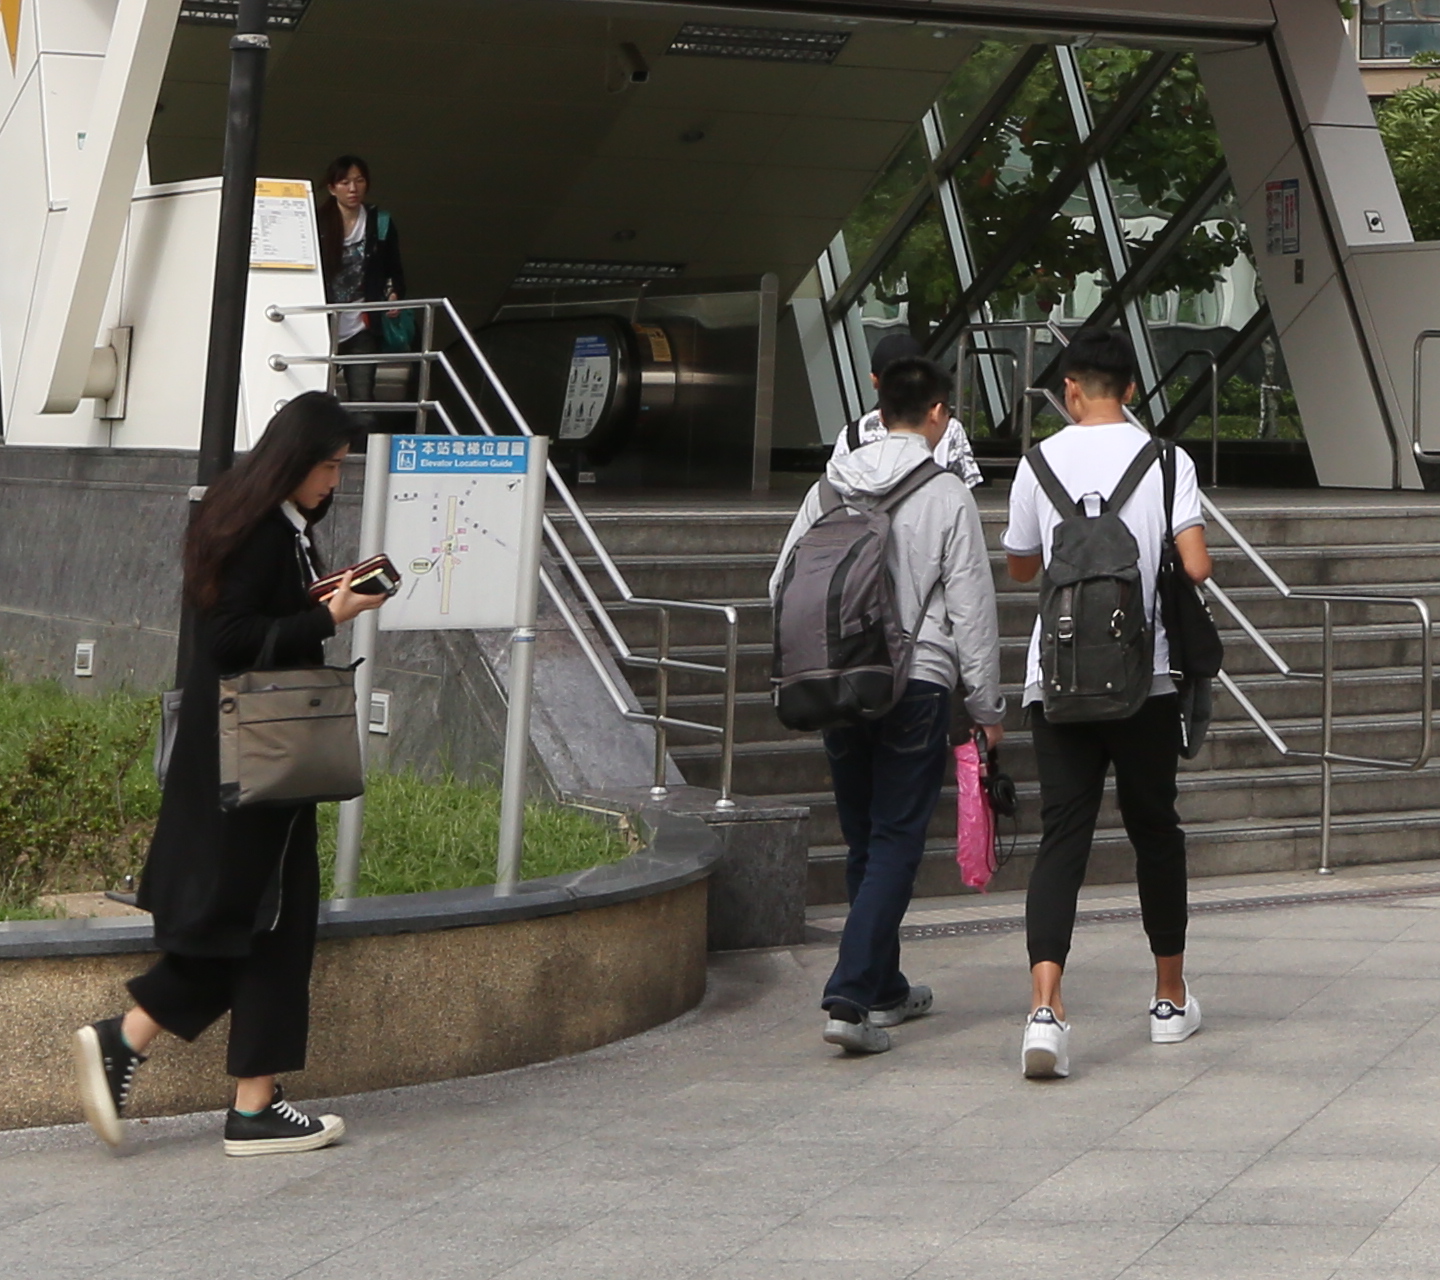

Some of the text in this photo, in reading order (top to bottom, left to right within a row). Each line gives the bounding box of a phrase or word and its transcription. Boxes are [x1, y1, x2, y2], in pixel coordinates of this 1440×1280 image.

[420, 459, 513, 468] Elevator Location Guide
